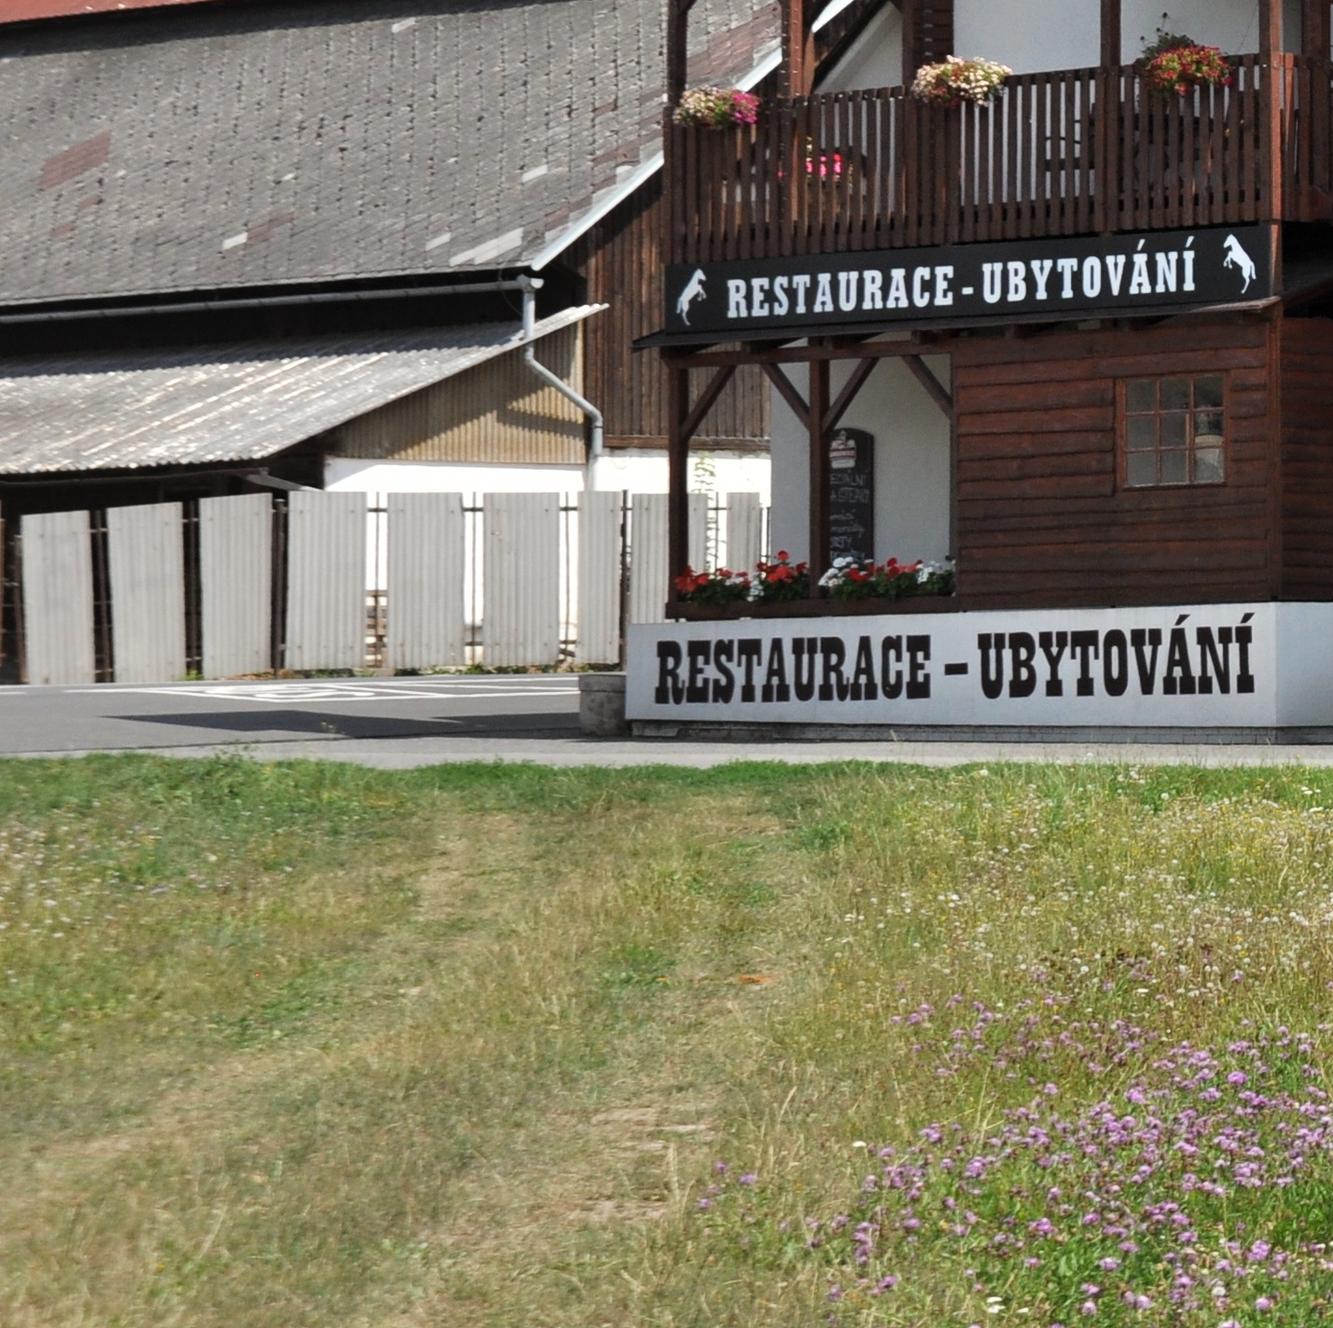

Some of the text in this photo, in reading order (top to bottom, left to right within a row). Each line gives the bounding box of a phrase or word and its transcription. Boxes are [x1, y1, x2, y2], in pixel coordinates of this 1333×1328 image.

[727, 265, 955, 319] RESTAURACE
[981, 235, 1197, 305] UBYTOVÁNÍ
[654, 634, 932, 705] RESTAURACE
[976, 612, 1256, 700] UBYTOVÁNÍ
